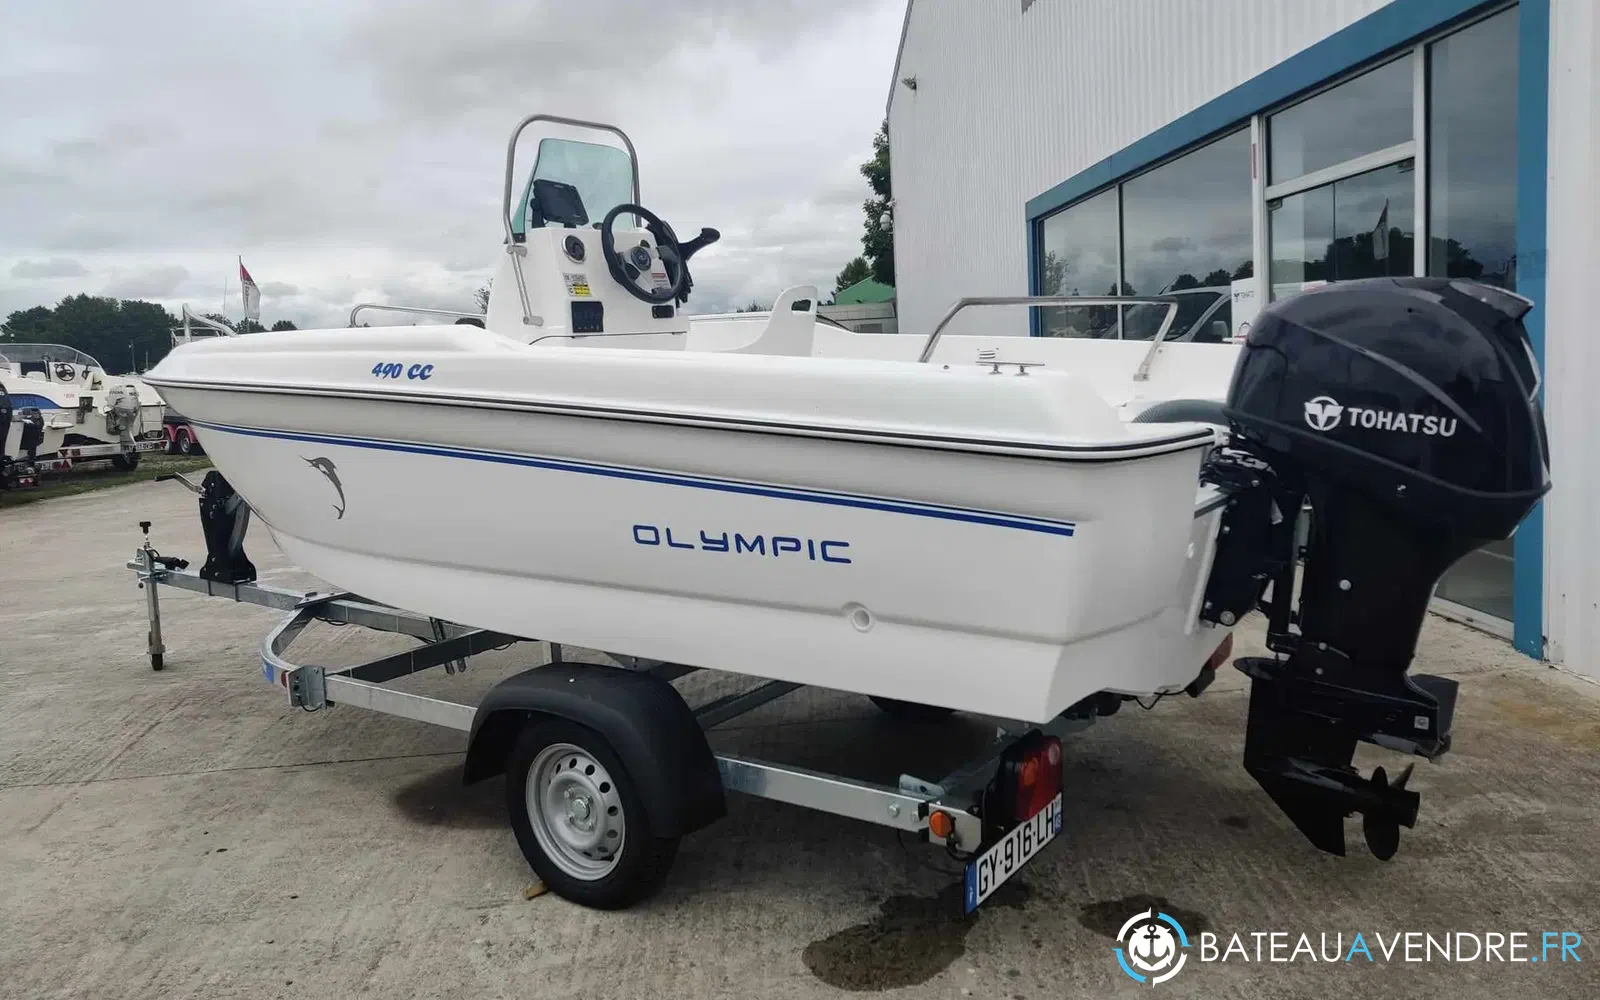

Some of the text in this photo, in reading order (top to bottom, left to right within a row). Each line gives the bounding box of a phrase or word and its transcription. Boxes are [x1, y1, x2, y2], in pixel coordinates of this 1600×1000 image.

[372, 362, 434, 380] 490 CC
[1348, 407, 1457, 437] TOHATSU
[633, 524, 852, 564] OLYMPIC
